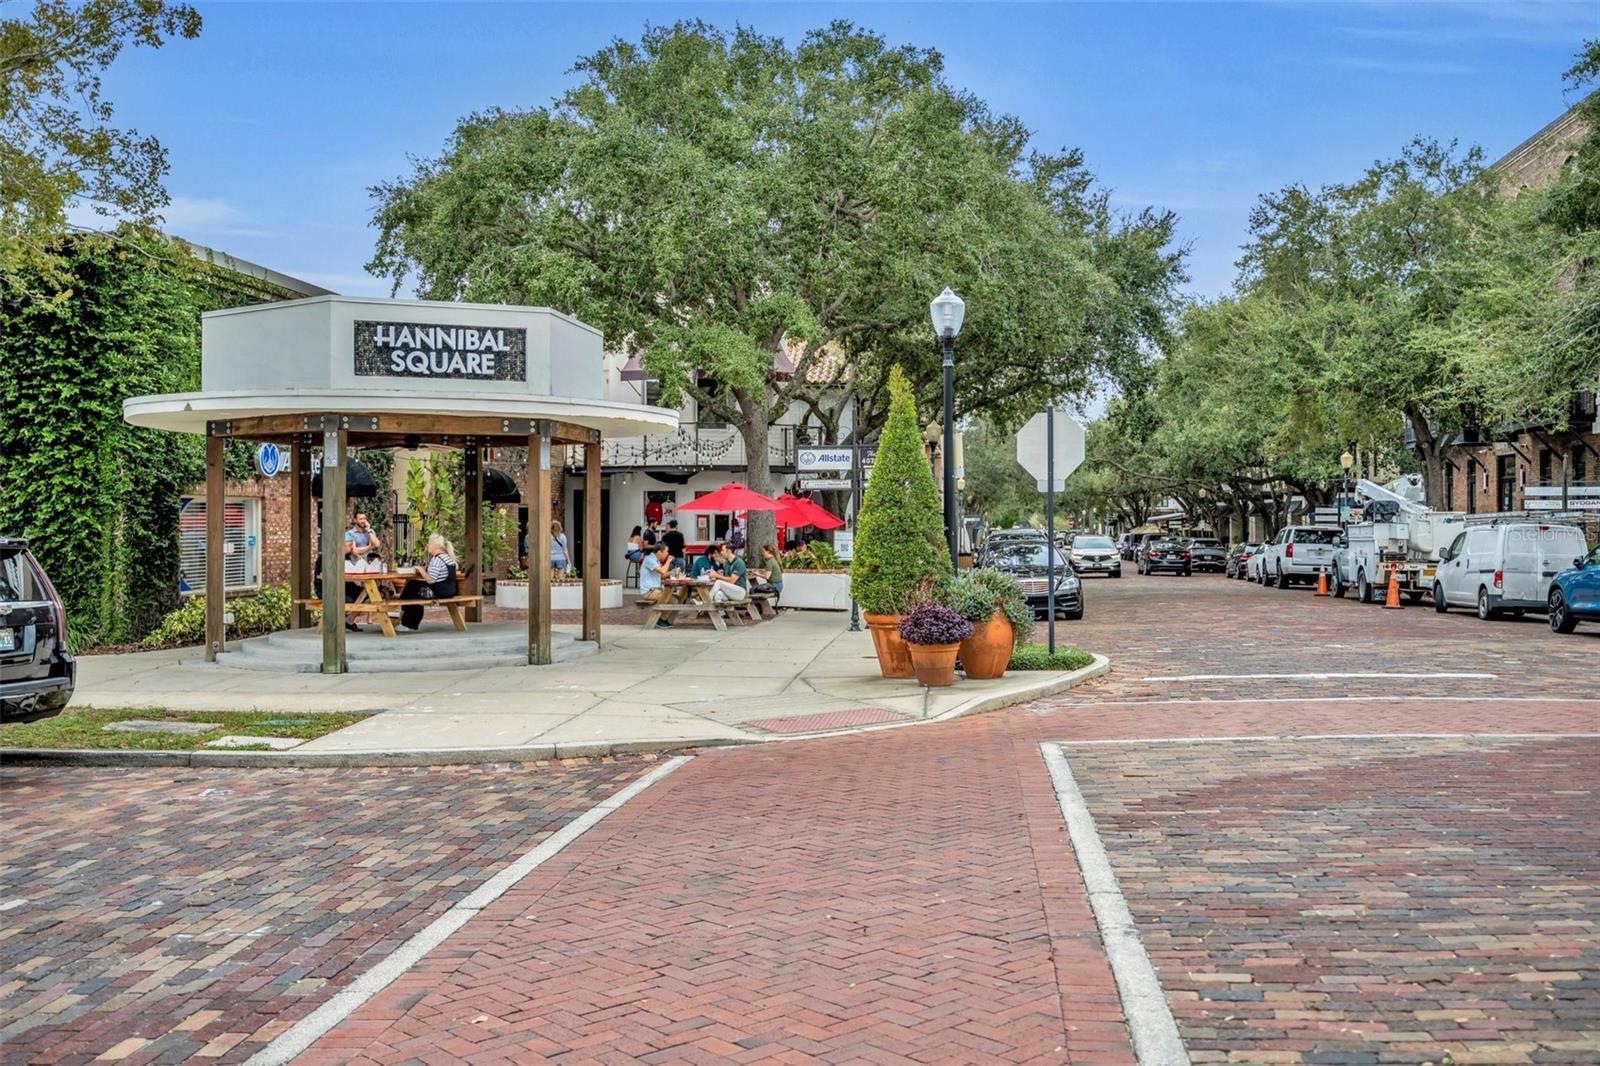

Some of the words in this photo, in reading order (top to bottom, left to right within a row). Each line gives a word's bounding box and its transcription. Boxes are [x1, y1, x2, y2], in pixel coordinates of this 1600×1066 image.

[373, 325, 510, 351] HANNIBAL
[390, 350, 495, 374] SQUARE
[818, 454, 850, 462] Allstate
